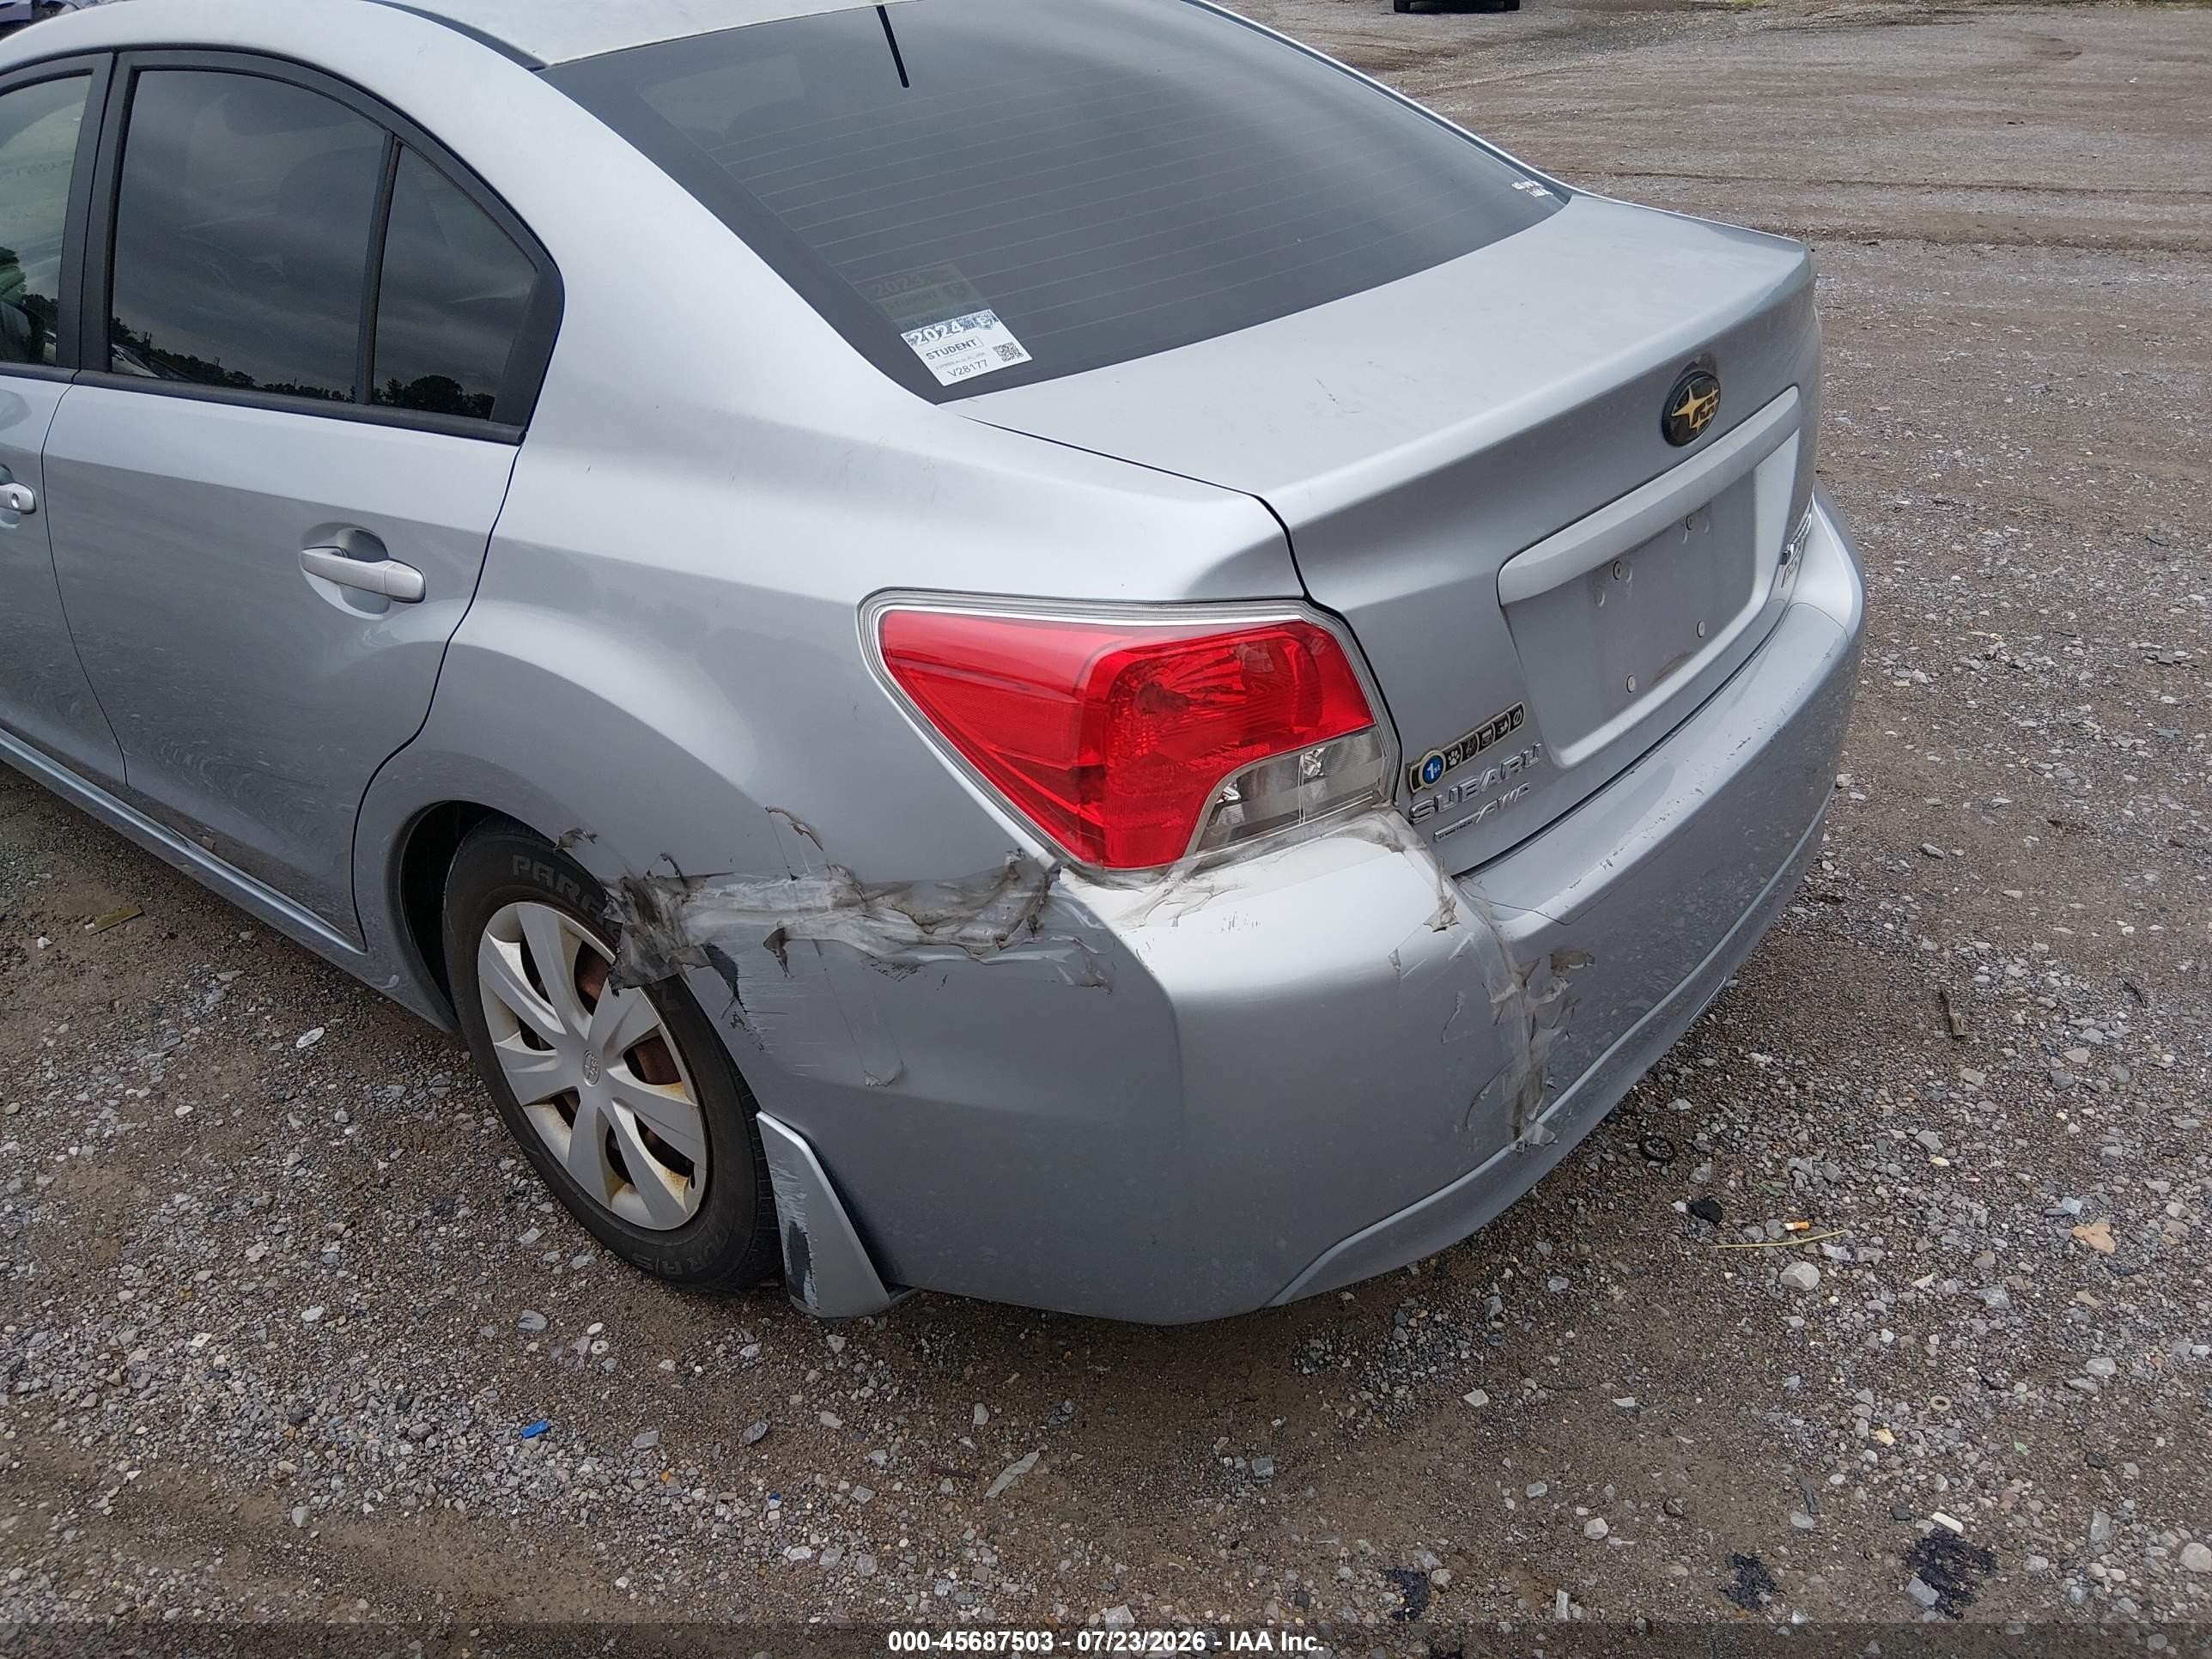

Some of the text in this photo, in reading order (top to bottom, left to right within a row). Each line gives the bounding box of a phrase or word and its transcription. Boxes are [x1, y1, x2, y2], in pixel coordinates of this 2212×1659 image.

[910, 320, 963, 344] 2024
[926, 338, 977, 360] STUDENT
[947, 359, 988, 377] V28177
[1426, 763, 1441, 779] 1st
[1409, 741, 1542, 825] SUBARU
